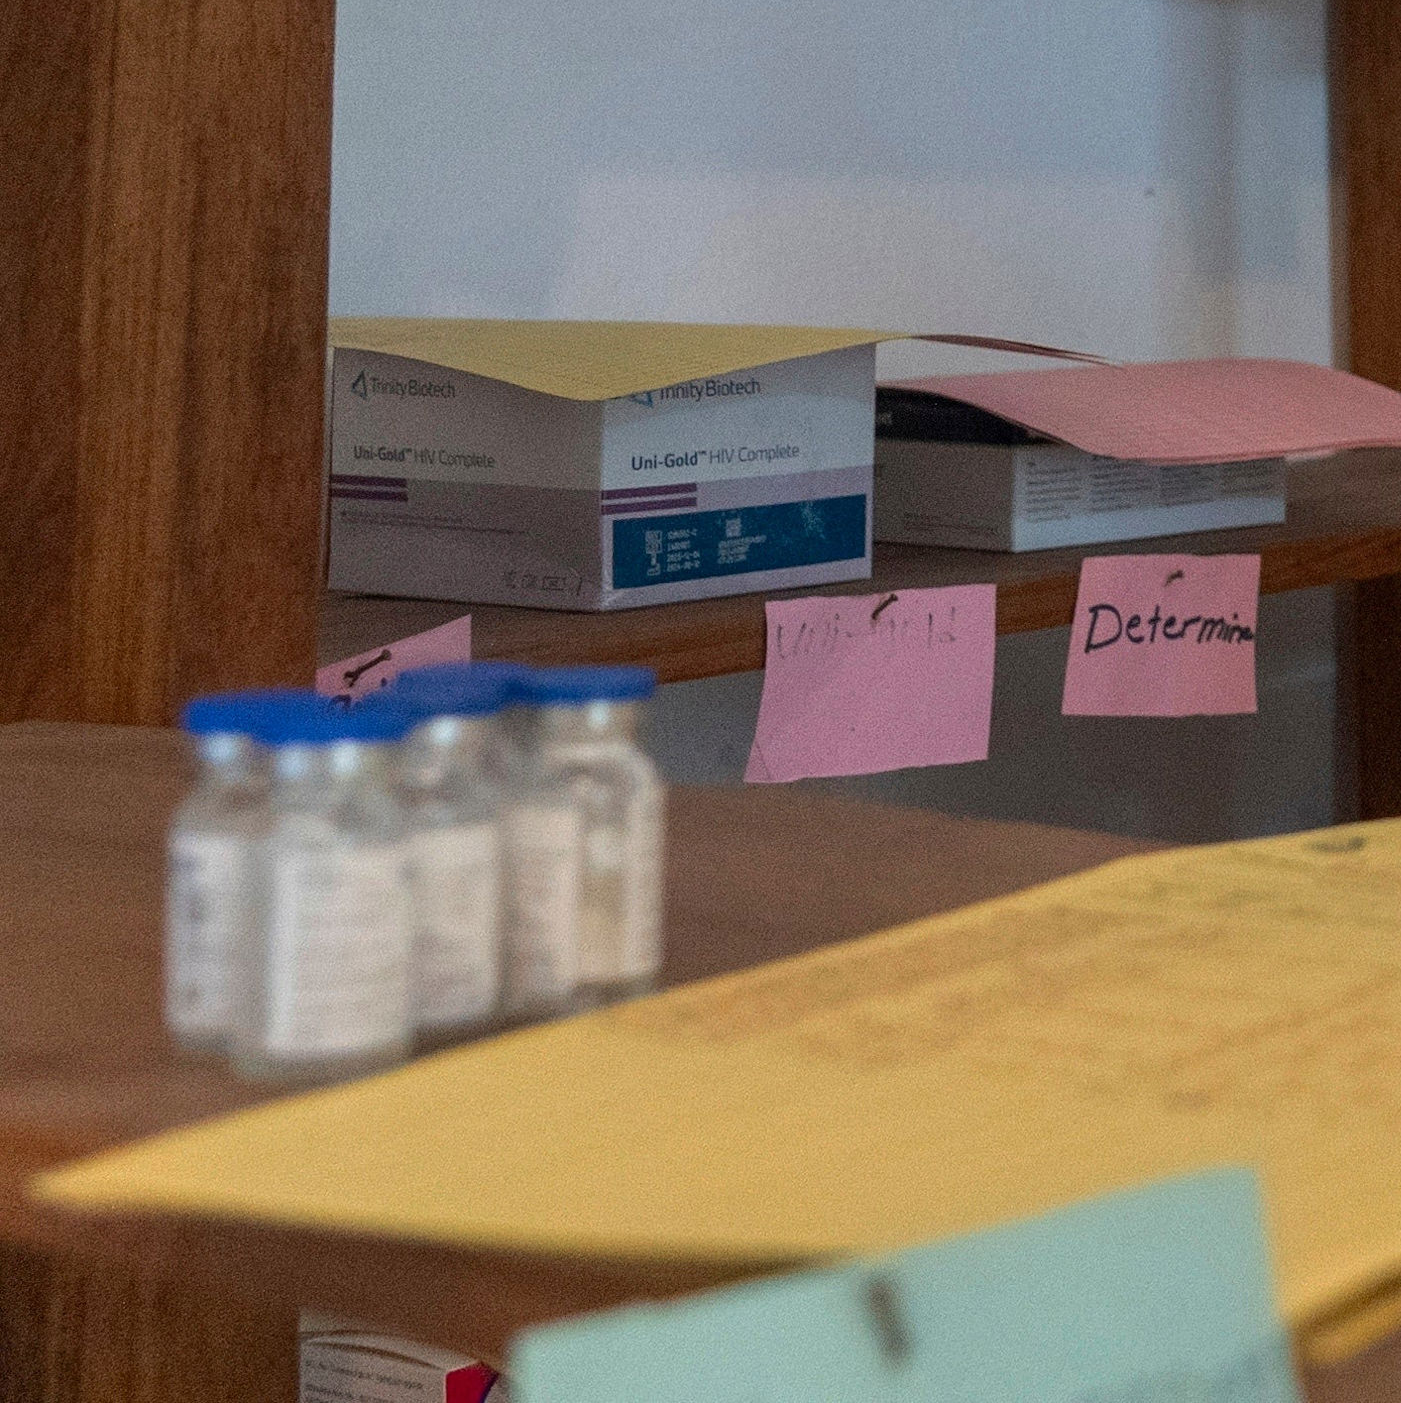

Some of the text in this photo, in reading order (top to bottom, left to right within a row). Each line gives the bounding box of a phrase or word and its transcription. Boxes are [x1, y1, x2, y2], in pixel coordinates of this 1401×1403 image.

[408, 379, 456, 398] Biotech
[705, 377, 761, 397] Biotech
[414, 449, 436, 465] HIV
[437, 450, 497, 469] Complete
[709, 448, 735, 465] HIV
[738, 445, 800, 463] Complete
[1085, 603, 1254, 654] Determine
